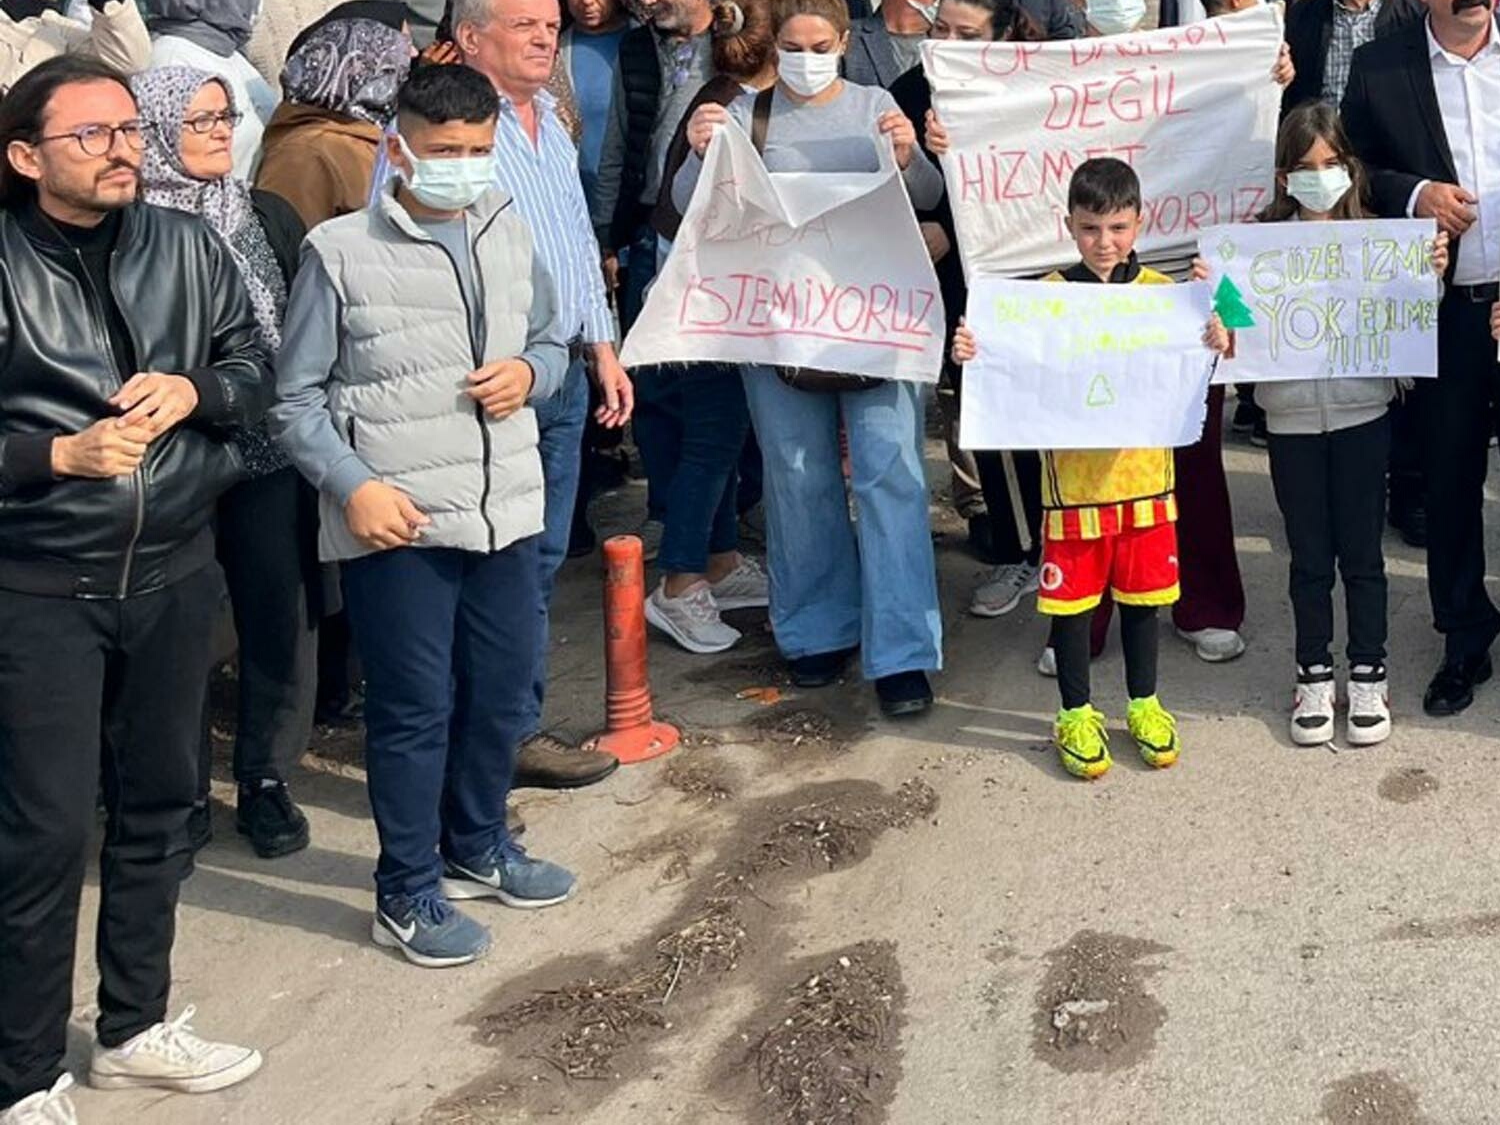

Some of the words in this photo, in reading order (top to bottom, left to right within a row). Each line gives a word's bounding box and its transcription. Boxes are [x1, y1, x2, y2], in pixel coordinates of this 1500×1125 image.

[1043, 65, 1193, 131] DEĞİL
[958, 145, 1148, 204] HİZMT
[679, 274, 935, 337] İSTEMİYORUZ
[1255, 293, 1347, 362] YOK
